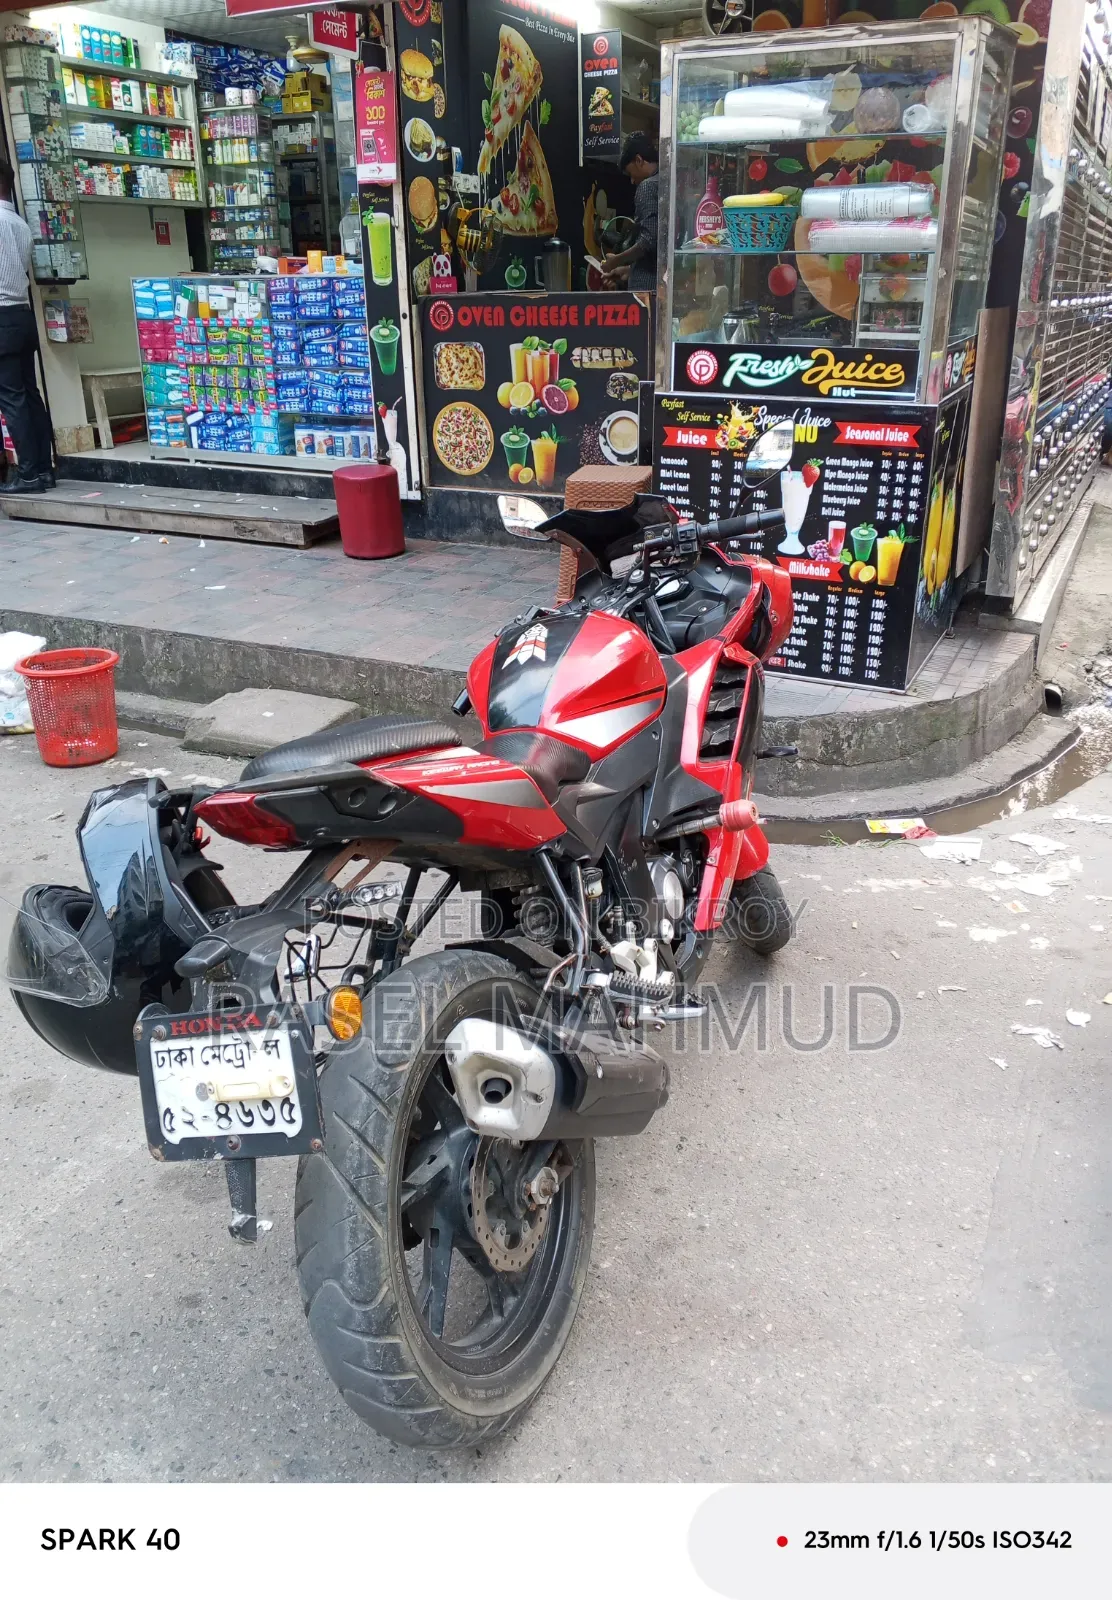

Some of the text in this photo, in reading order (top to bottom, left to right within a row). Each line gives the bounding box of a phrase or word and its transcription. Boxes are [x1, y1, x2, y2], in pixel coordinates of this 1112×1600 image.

[322, 20, 347, 39] পেমেন্ট
[584, 70, 603, 78] CHEESE
[585, 135, 619, 147] Self Service
[510, 305, 579, 326] CHEESE
[584, 304, 640, 326] PIZZA
[722, 353, 800, 387] Fresh
[801, 348, 905, 394] Juice
[661, 398, 684, 410] Payfast
[676, 411, 710, 423] Self Service
[799, 407, 832, 427] Juice
[676, 430, 708, 445] Juice
[845, 426, 909, 443] Seasonal Juice
[660, 456, 688, 466] Lemonade
[734, 461, 744, 470] 30/
[825, 457, 840, 466] Green
[841, 457, 859, 468] Mango
[859, 458, 873, 468] Juice
[733, 475, 743, 484] 50/
[825, 469, 836, 480] Ripe
[837, 470, 854, 481] Mango
[855, 471, 869, 480] Juice
[660, 482, 676, 491] Sweet
[711, 486, 722, 496] 70/-
[823, 482, 853, 493] Watermelon
[854, 484, 868, 493] Juice
[676, 496, 690, 505] Juice
[709, 498, 721, 509] 70/-
[822, 495, 846, 507] Blueberry
[847, 496, 860, 505] Juice
[680, 509, 695, 518] Juice
[832, 508, 845, 517] Juice
[789, 560, 831, 578] Milkshake
[802, 592, 820, 602] Shake
[827, 594, 839, 605] 70/-
[845, 596, 860, 607] 100/-
[872, 598, 887, 610] 120/-
[793, 602, 886, 622] hake 70/- 100/- 120/-
[801, 615, 818, 625] Shake
[825, 618, 837, 628] 70/-
[842, 619, 858, 630] 100/-
[869, 622, 885, 634] 120/-
[823, 629, 835, 640] 70/-
[841, 631, 856, 642] 100/-
[868, 634, 883, 646] 120/-
[790, 636, 808, 646] Shake
[823, 641, 834, 652] 70/-
[840, 643, 855, 654] 100/-
[867, 646, 882, 657] 120/-
[782, 646, 799, 656] Shake
[840, 654, 855, 666] 120/-
[787, 659, 807, 669] Shake
[821, 664, 832, 674] 90/-
[839, 666, 853, 677] 120/-
[170, 1013, 263, 1036] HONDA
[155, 1046, 194, 1068] ঢাকা
